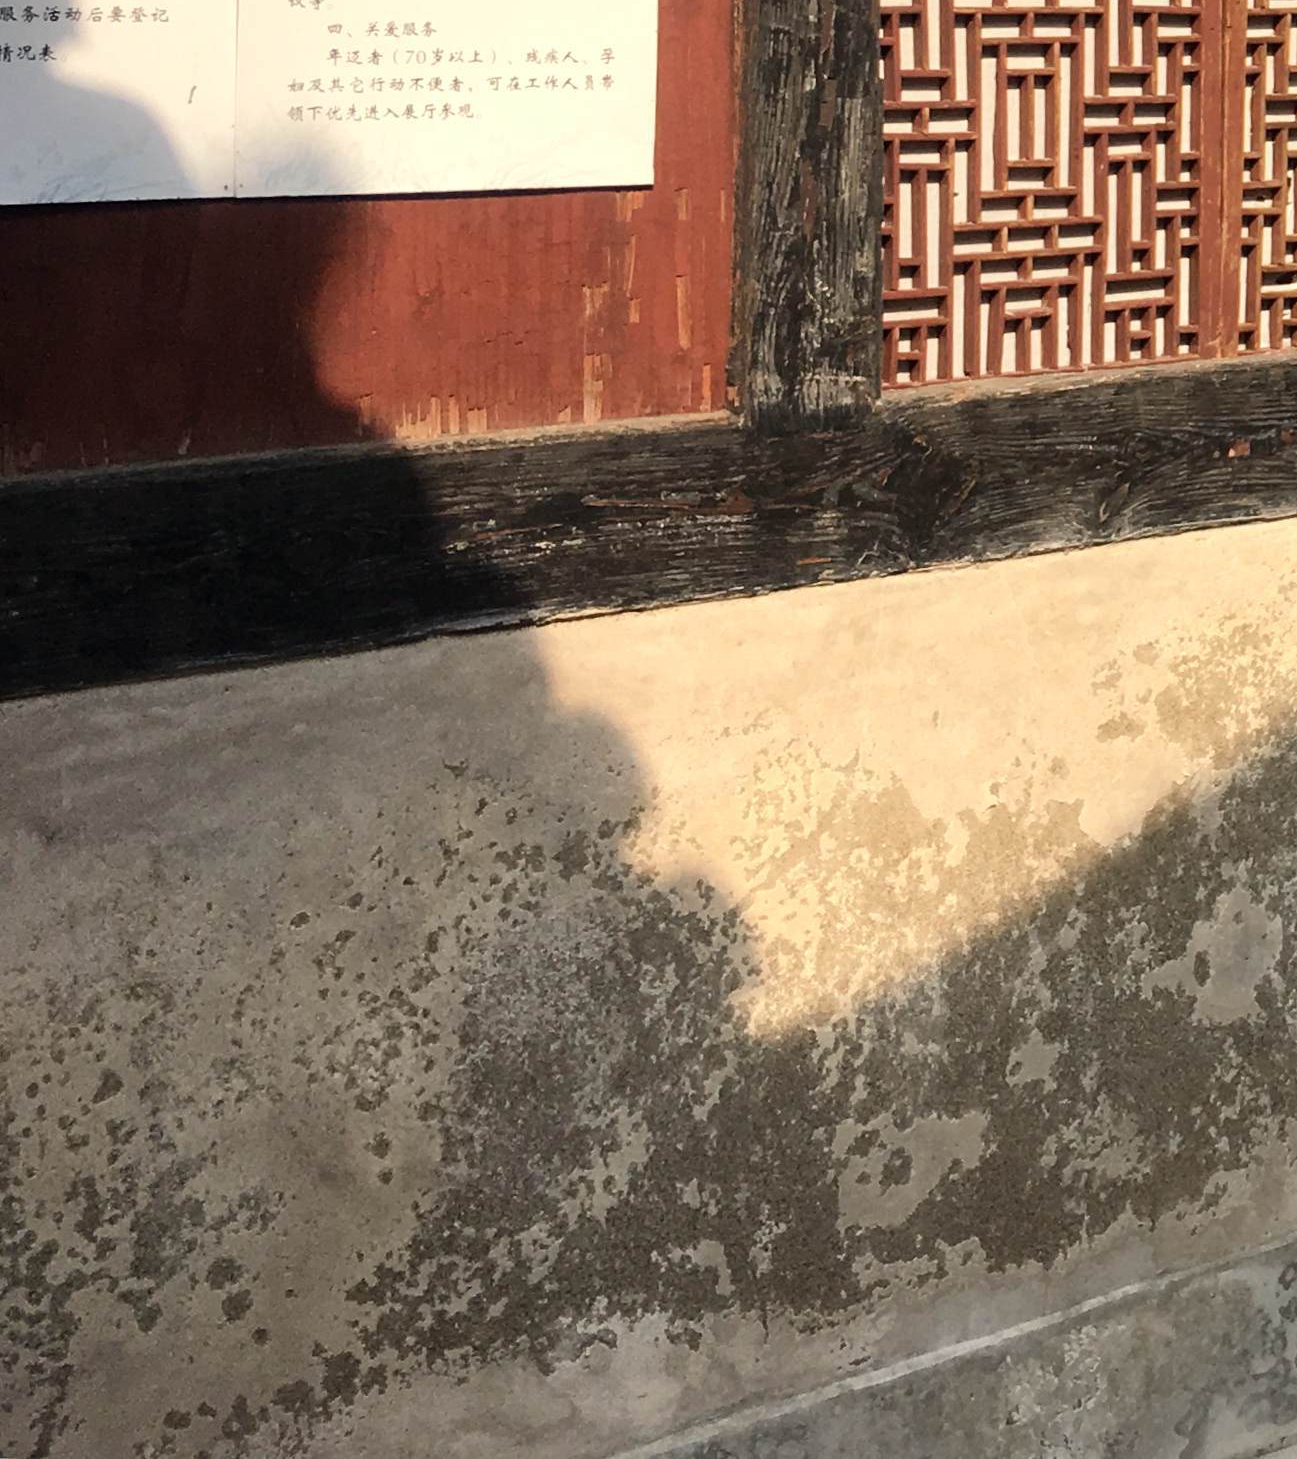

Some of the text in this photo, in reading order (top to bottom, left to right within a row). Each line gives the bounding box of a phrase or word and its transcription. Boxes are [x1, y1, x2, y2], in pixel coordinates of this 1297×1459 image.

[327, 21, 437, 38] 四、关爱服务
